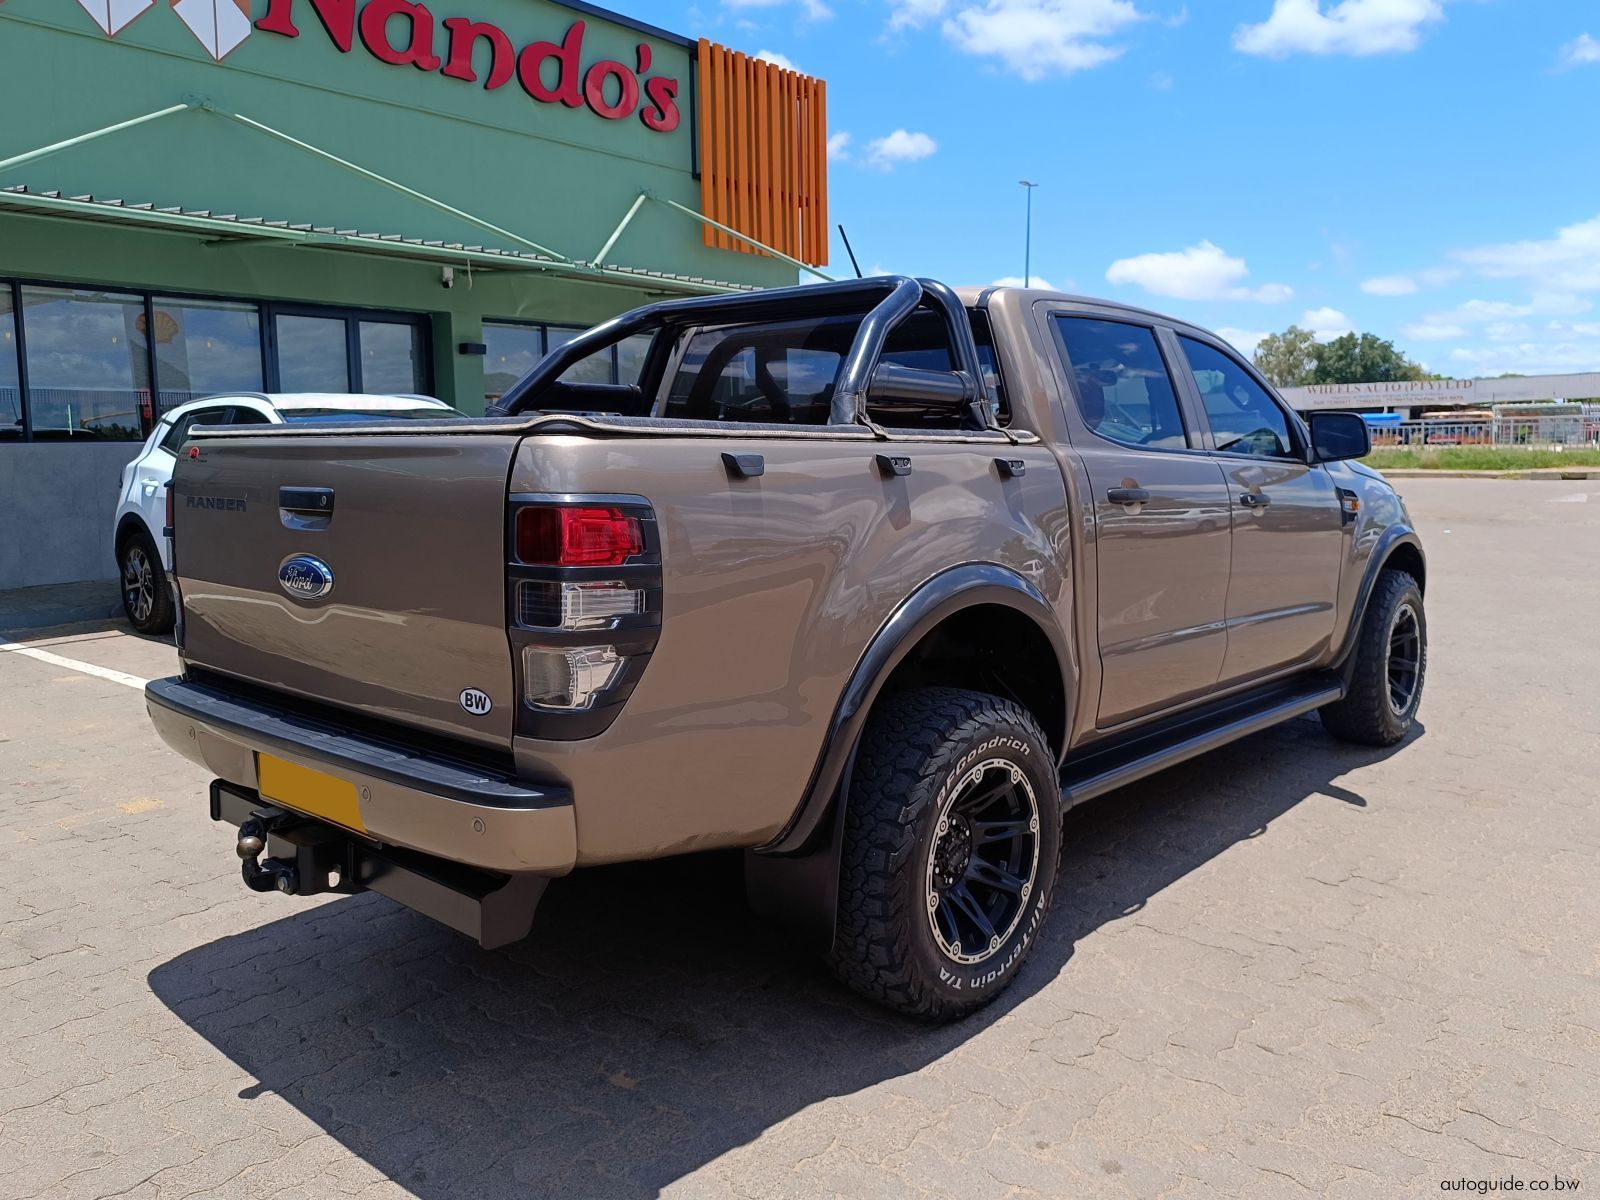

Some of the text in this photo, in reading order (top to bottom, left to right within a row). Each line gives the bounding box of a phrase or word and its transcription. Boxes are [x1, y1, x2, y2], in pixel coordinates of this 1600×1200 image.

[1306, 385, 1361, 395] WHEELS
[1366, 382, 1401, 393] AUTO
[1445, 379, 1473, 391] LTD
[186, 496, 247, 513] RANGER
[285, 564, 314, 590] Ford
[465, 692, 487, 711] BW
[937, 736, 1031, 808] BFGoodrich
[939, 966, 962, 990] T/A
